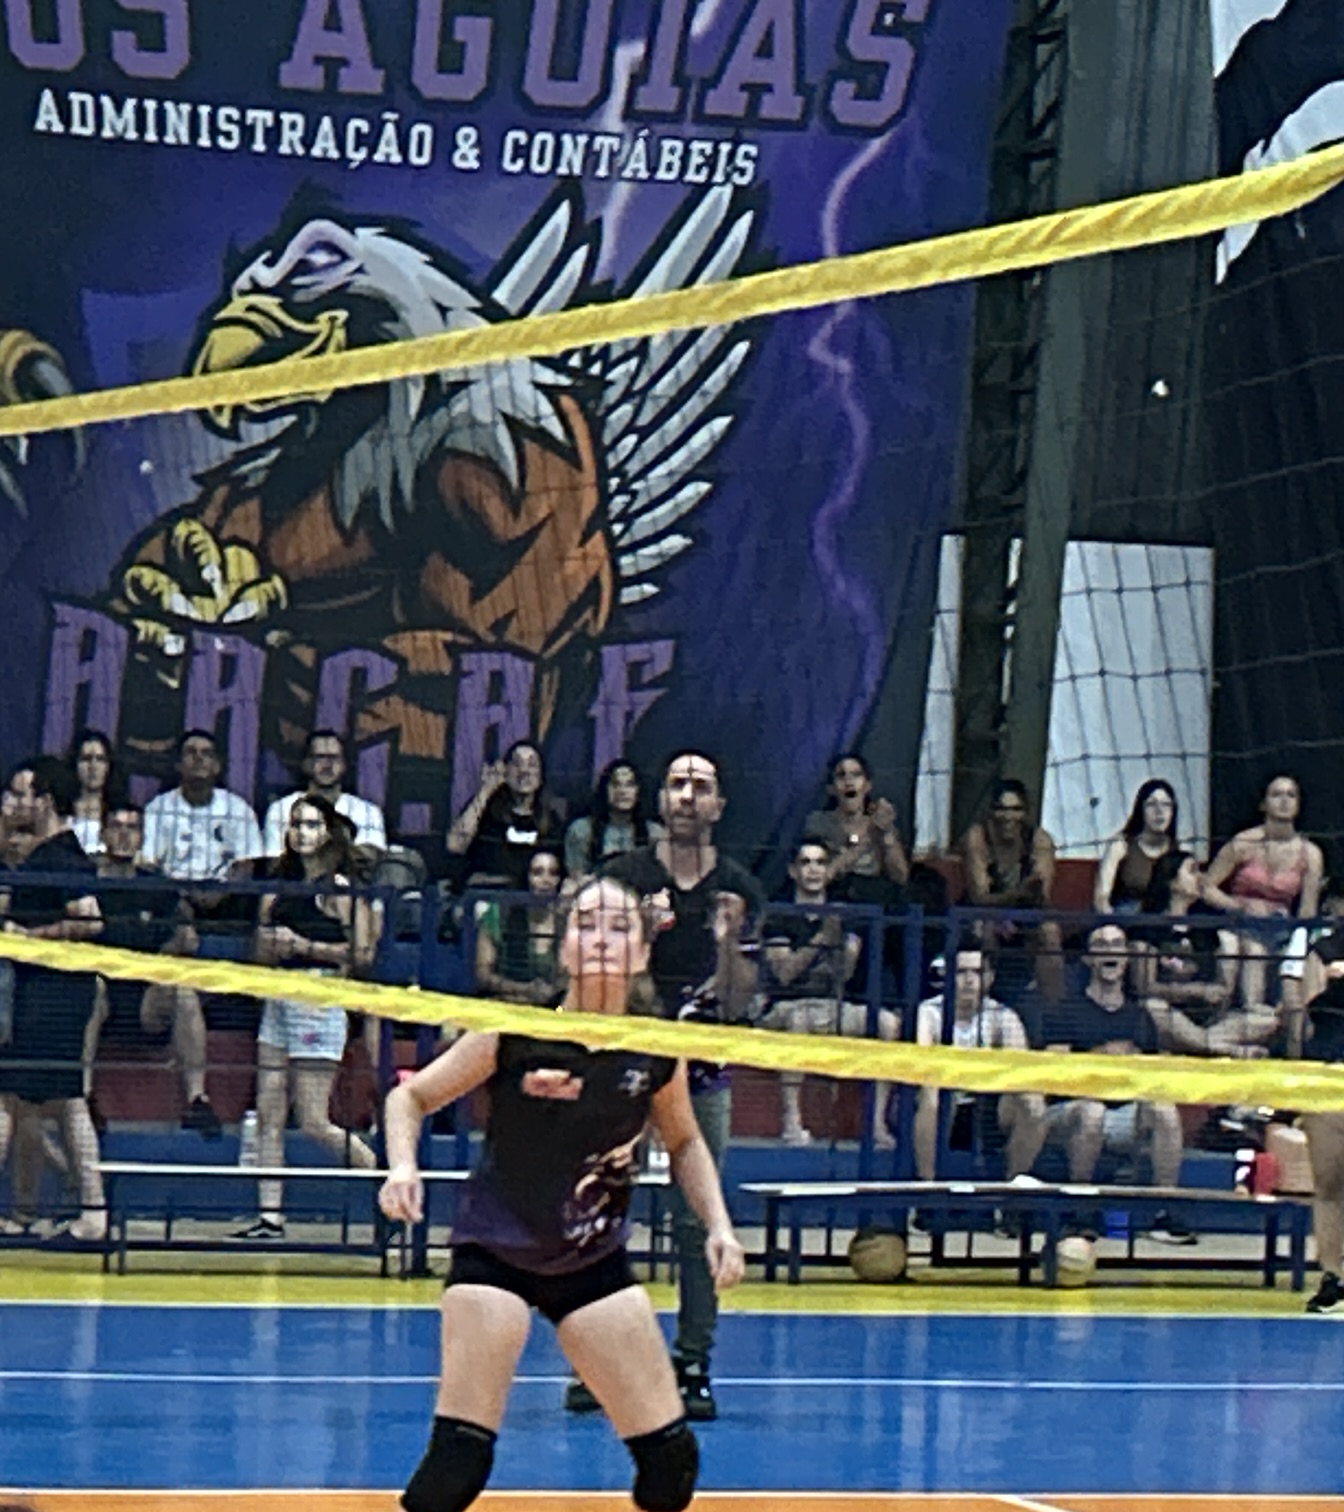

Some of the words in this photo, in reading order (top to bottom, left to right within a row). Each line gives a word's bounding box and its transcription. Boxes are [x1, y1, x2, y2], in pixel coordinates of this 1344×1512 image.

[33, 87, 434, 169] ADMINISTRAÇÃO
[451, 126, 481, 170] &
[502, 129, 759, 186] CONTÁBEIS
